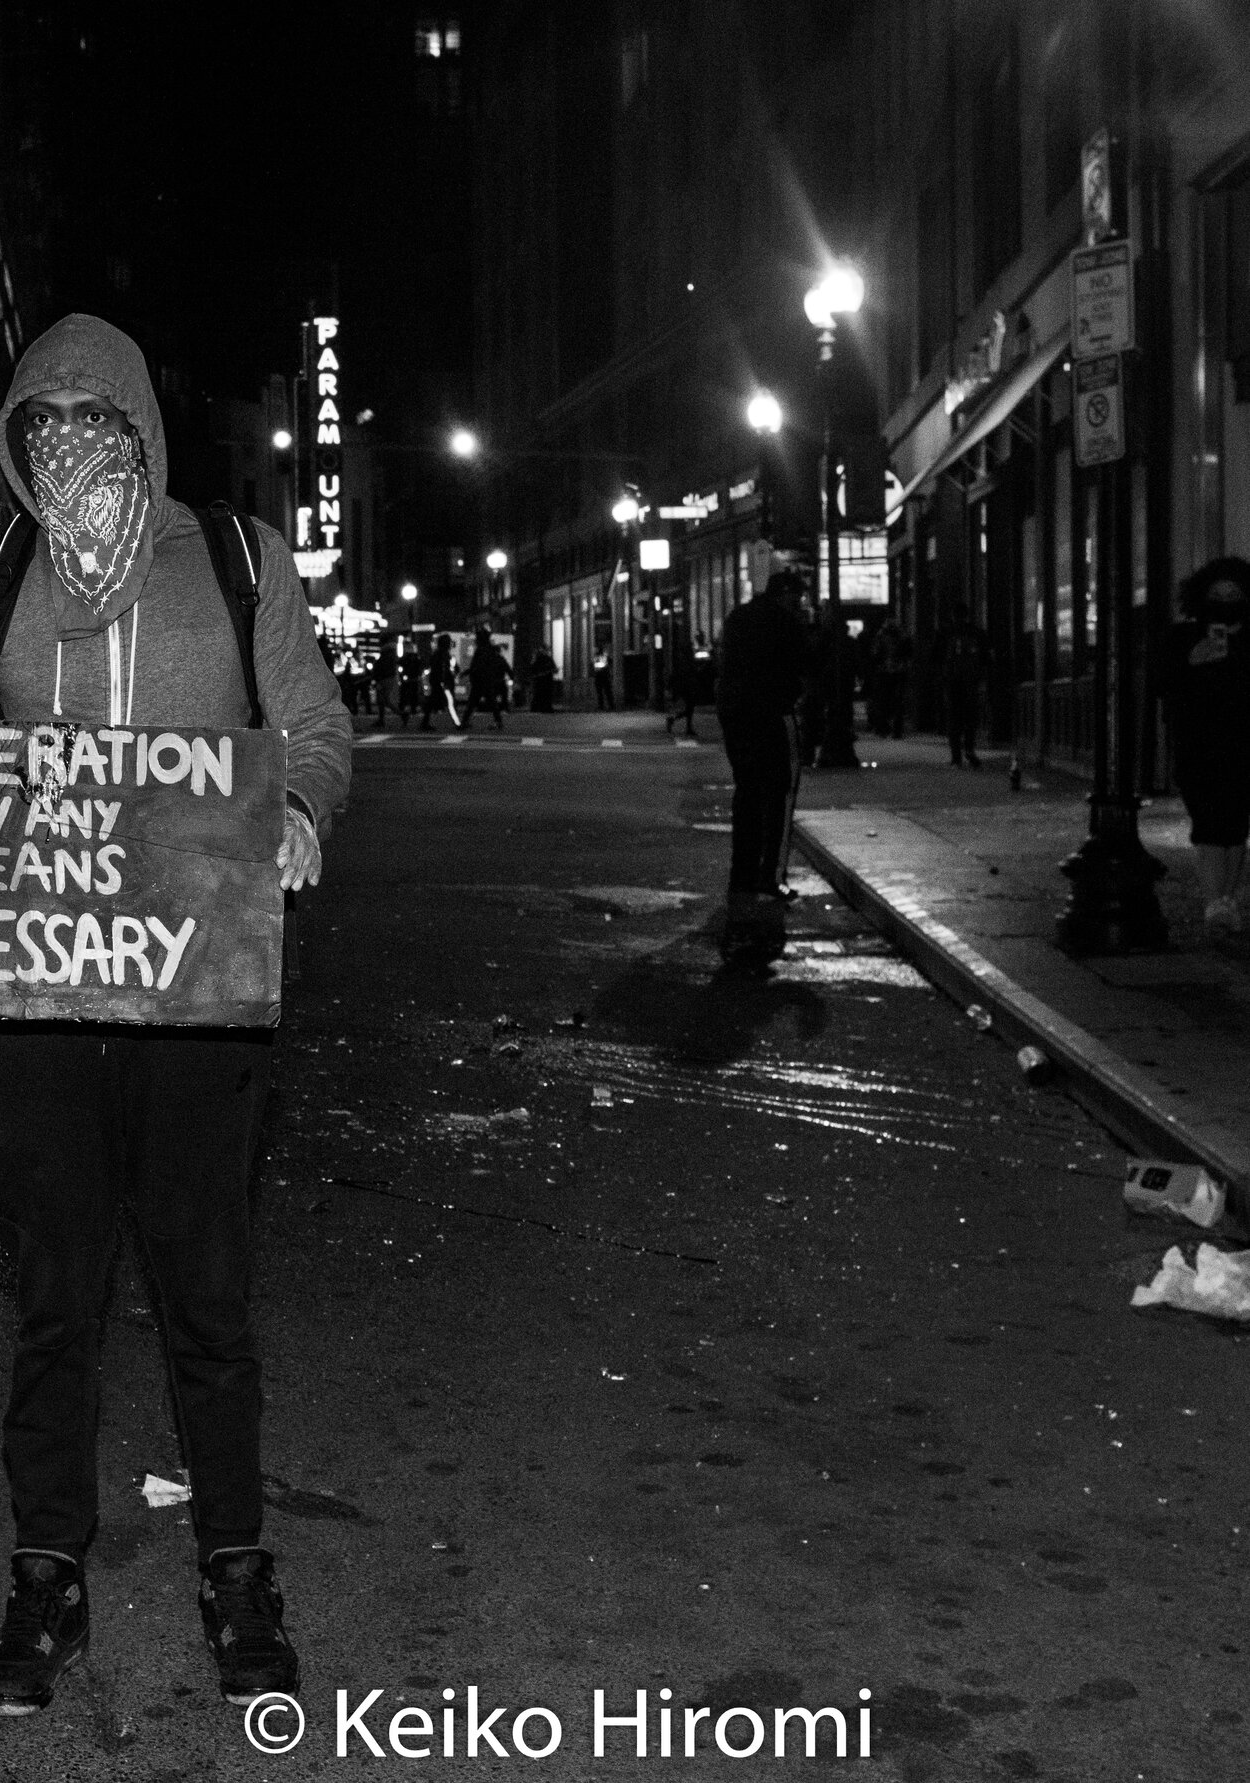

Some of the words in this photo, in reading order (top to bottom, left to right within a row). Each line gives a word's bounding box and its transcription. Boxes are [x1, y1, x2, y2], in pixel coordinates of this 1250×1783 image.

[1090, 272, 1113, 289] NO
[313, 317, 341, 548] PARAMOUNT
[24, 796, 122, 841] ANY
